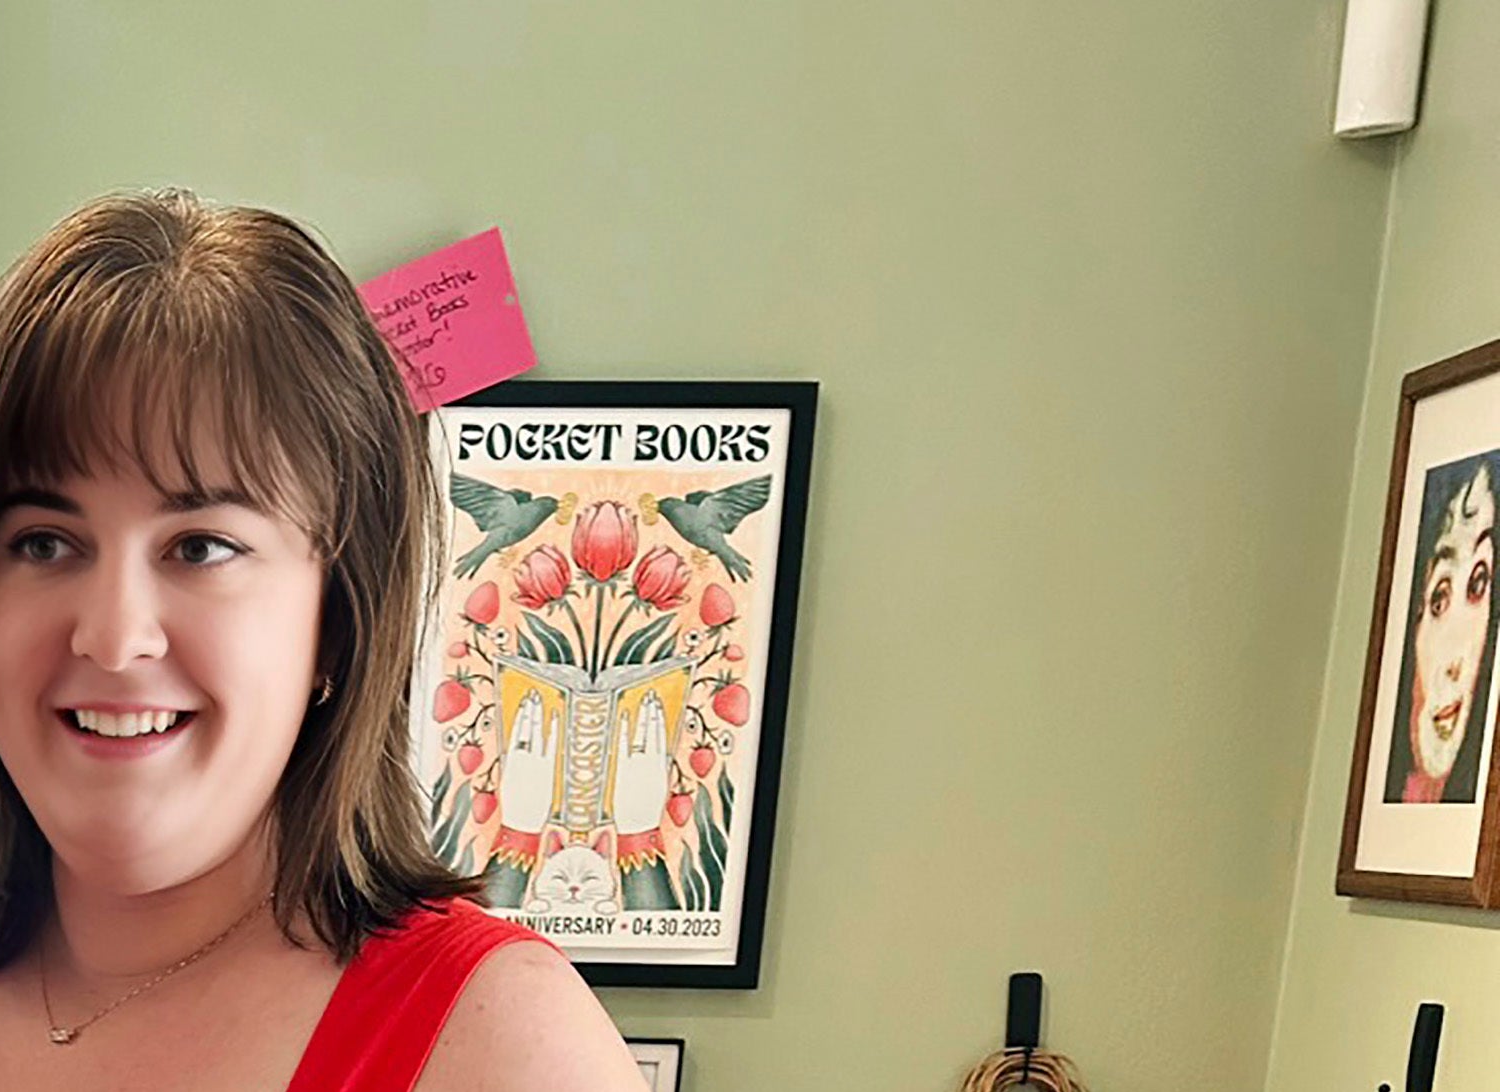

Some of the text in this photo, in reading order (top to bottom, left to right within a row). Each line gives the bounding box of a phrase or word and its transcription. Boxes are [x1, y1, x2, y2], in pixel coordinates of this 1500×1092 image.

[458, 423, 772, 462] POCKET BOOKS
[631, 918, 722, 937] 04.30.2023
